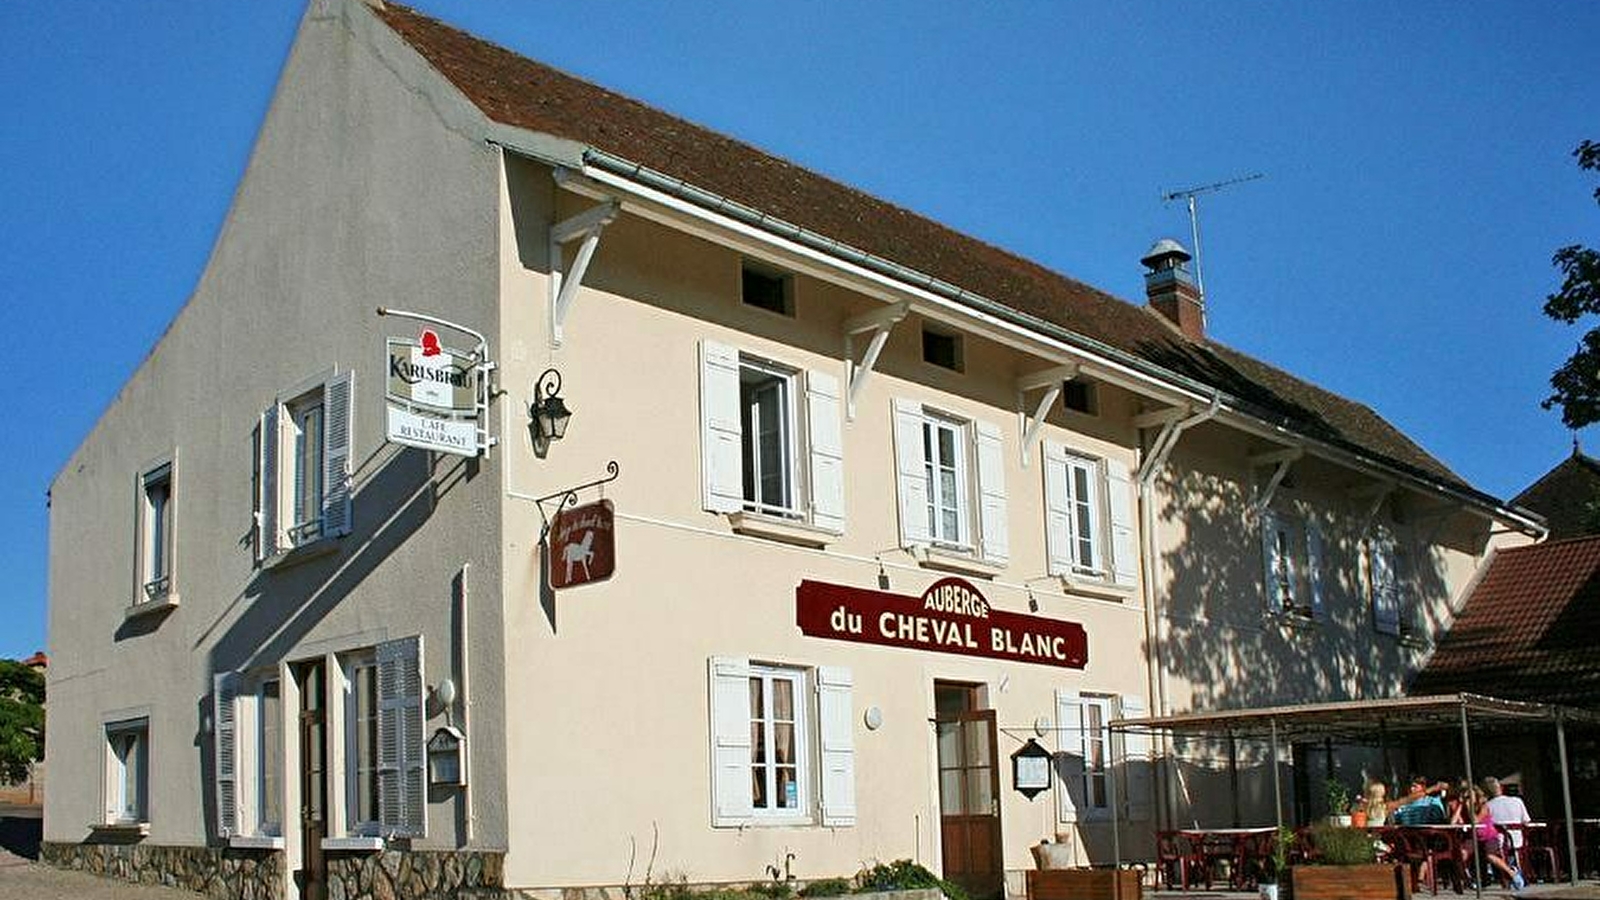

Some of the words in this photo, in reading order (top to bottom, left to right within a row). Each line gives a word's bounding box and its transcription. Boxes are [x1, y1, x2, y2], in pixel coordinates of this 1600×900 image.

[401, 425, 467, 446] RESTAURANT
[924, 585, 989, 620] AUBERGE
[830, 606, 863, 634] du
[879, 611, 978, 648] CHEVAL
[990, 628, 1067, 660] BLANC
